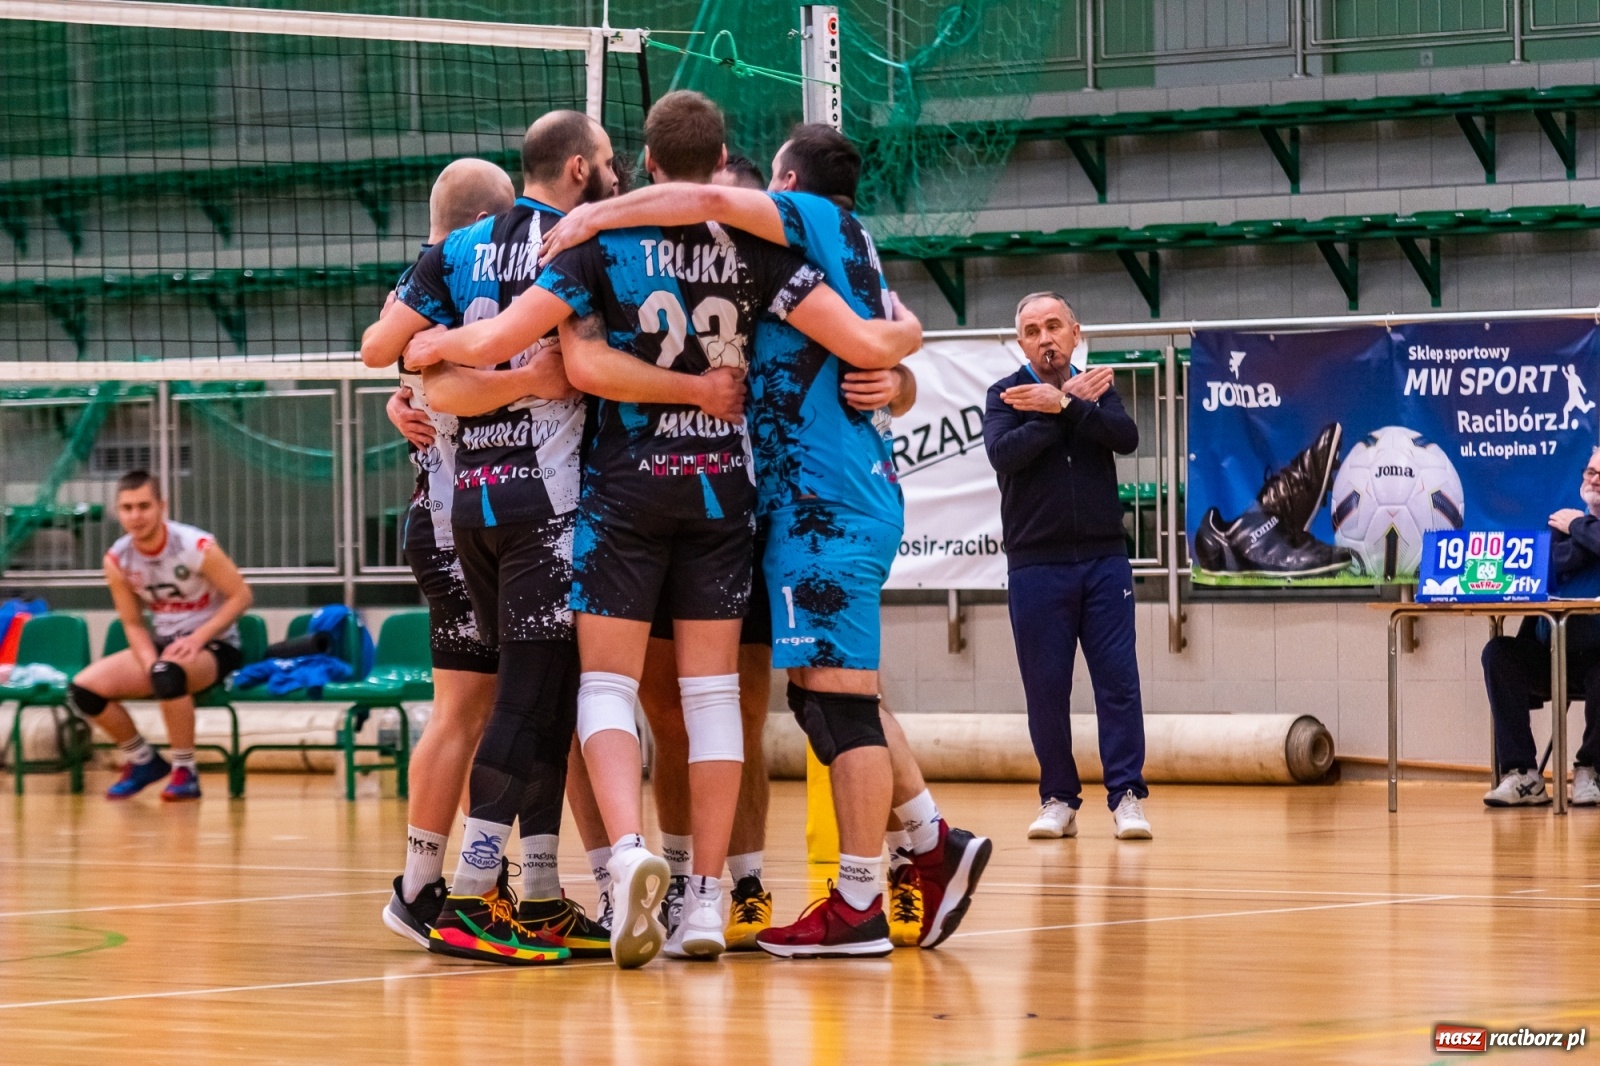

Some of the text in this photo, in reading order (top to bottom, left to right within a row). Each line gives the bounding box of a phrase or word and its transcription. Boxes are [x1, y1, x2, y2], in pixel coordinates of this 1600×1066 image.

[1408, 345, 1510, 363] Sklep sportowy
[1403, 364, 1558, 396] MW SPORT
[1457, 406, 1557, 433] Racibórz
[1460, 441, 1557, 459] ul. Chopina 17
[1437, 537, 1534, 569] 19 0 0 25
[782, 586, 795, 628] 1
[776, 636, 815, 646] regio
